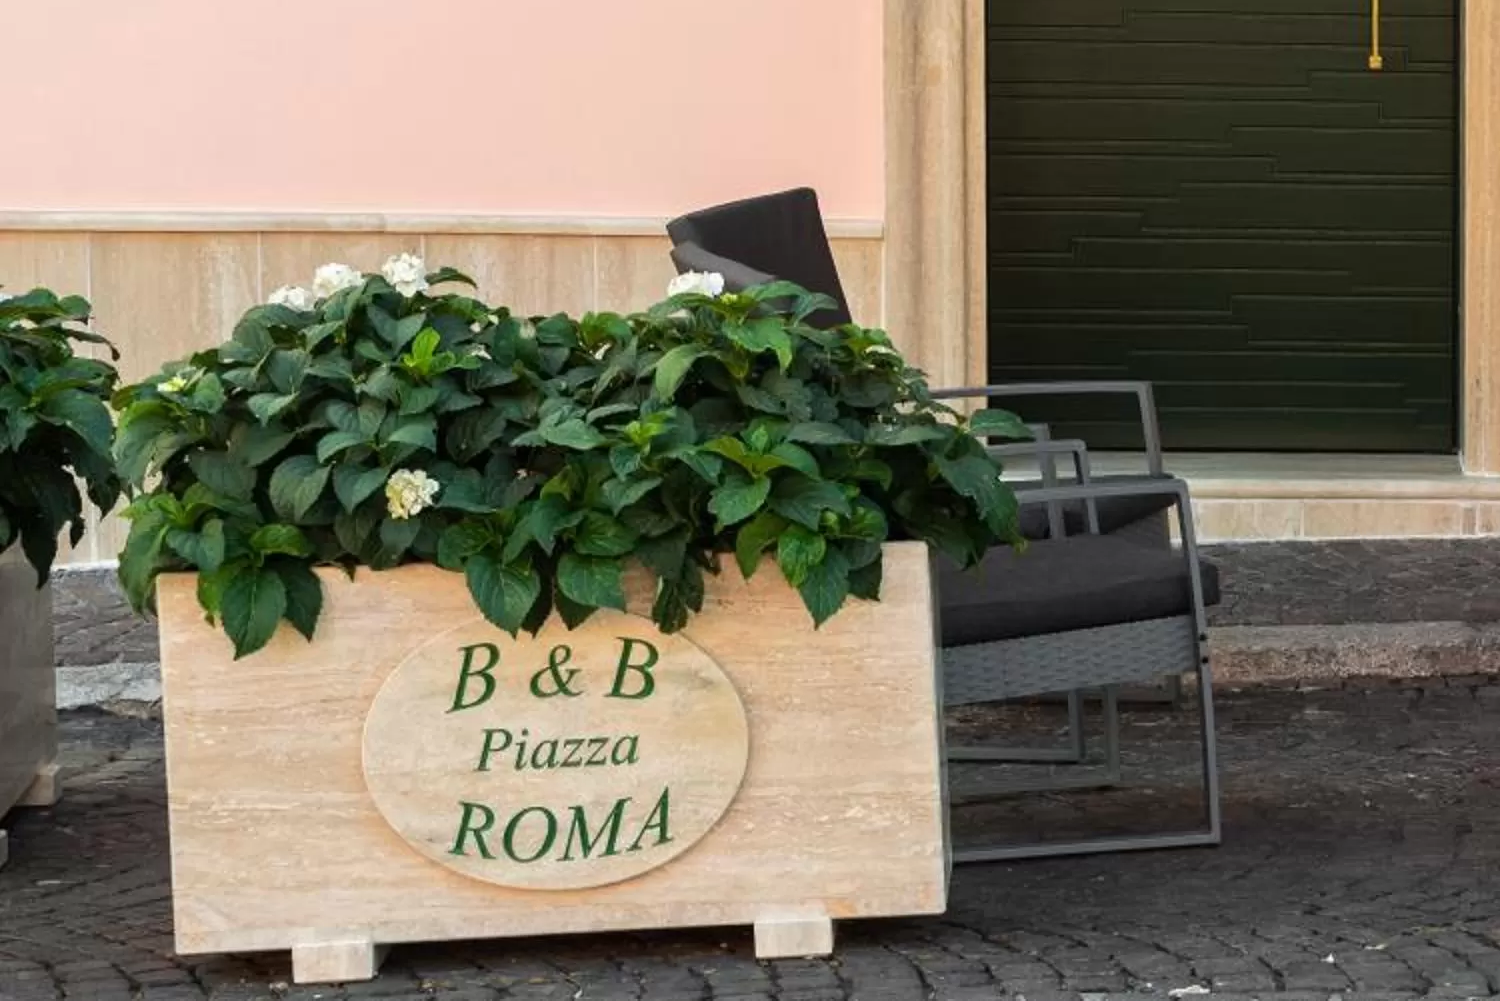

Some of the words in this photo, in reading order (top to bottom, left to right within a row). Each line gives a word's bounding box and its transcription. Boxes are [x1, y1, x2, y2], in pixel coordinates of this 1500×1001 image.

[444, 641, 501, 715] B
[529, 644, 585, 698] &
[604, 636, 660, 700] B
[474, 727, 641, 772] Piazza
[448, 785, 675, 864] ROMA
